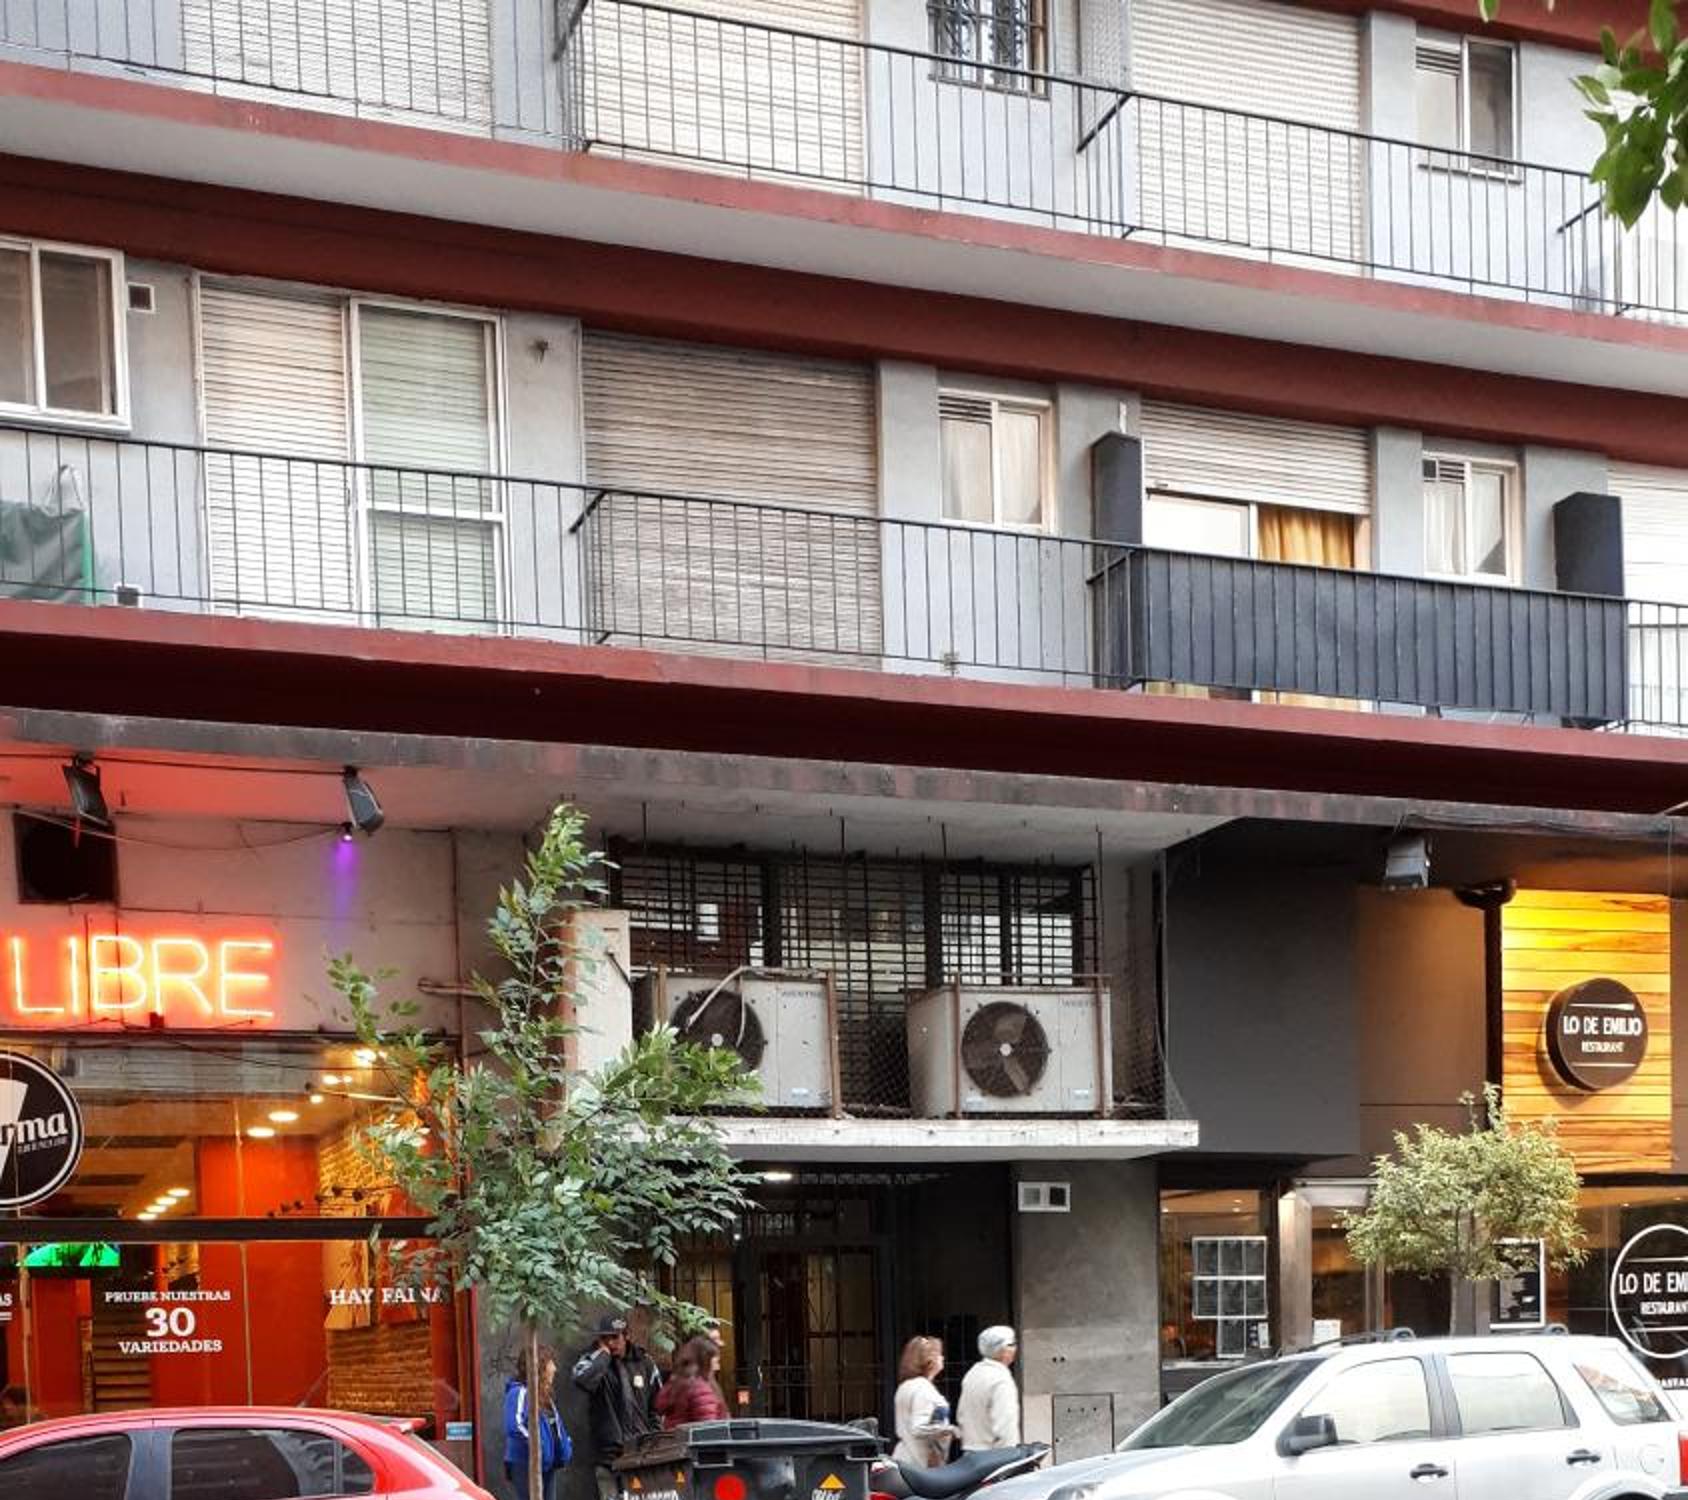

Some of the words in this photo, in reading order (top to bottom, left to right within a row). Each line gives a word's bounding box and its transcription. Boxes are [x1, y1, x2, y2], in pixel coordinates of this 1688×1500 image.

[12, 934, 274, 1017] LIBRE
[1563, 1016, 1580, 1035] LO
[1583, 1016, 1600, 1035] DE
[1603, 1017, 1642, 1036] EMILIO
[1619, 1273, 1638, 1294] LO
[1643, 1272, 1662, 1293] DE
[105, 1291, 158, 1303] PRUEBE
[161, 1290, 231, 1302] NUESTRAS
[330, 1287, 374, 1305] HAY
[145, 1307, 196, 1337] 30
[118, 1339, 223, 1354] VARIEDADES
